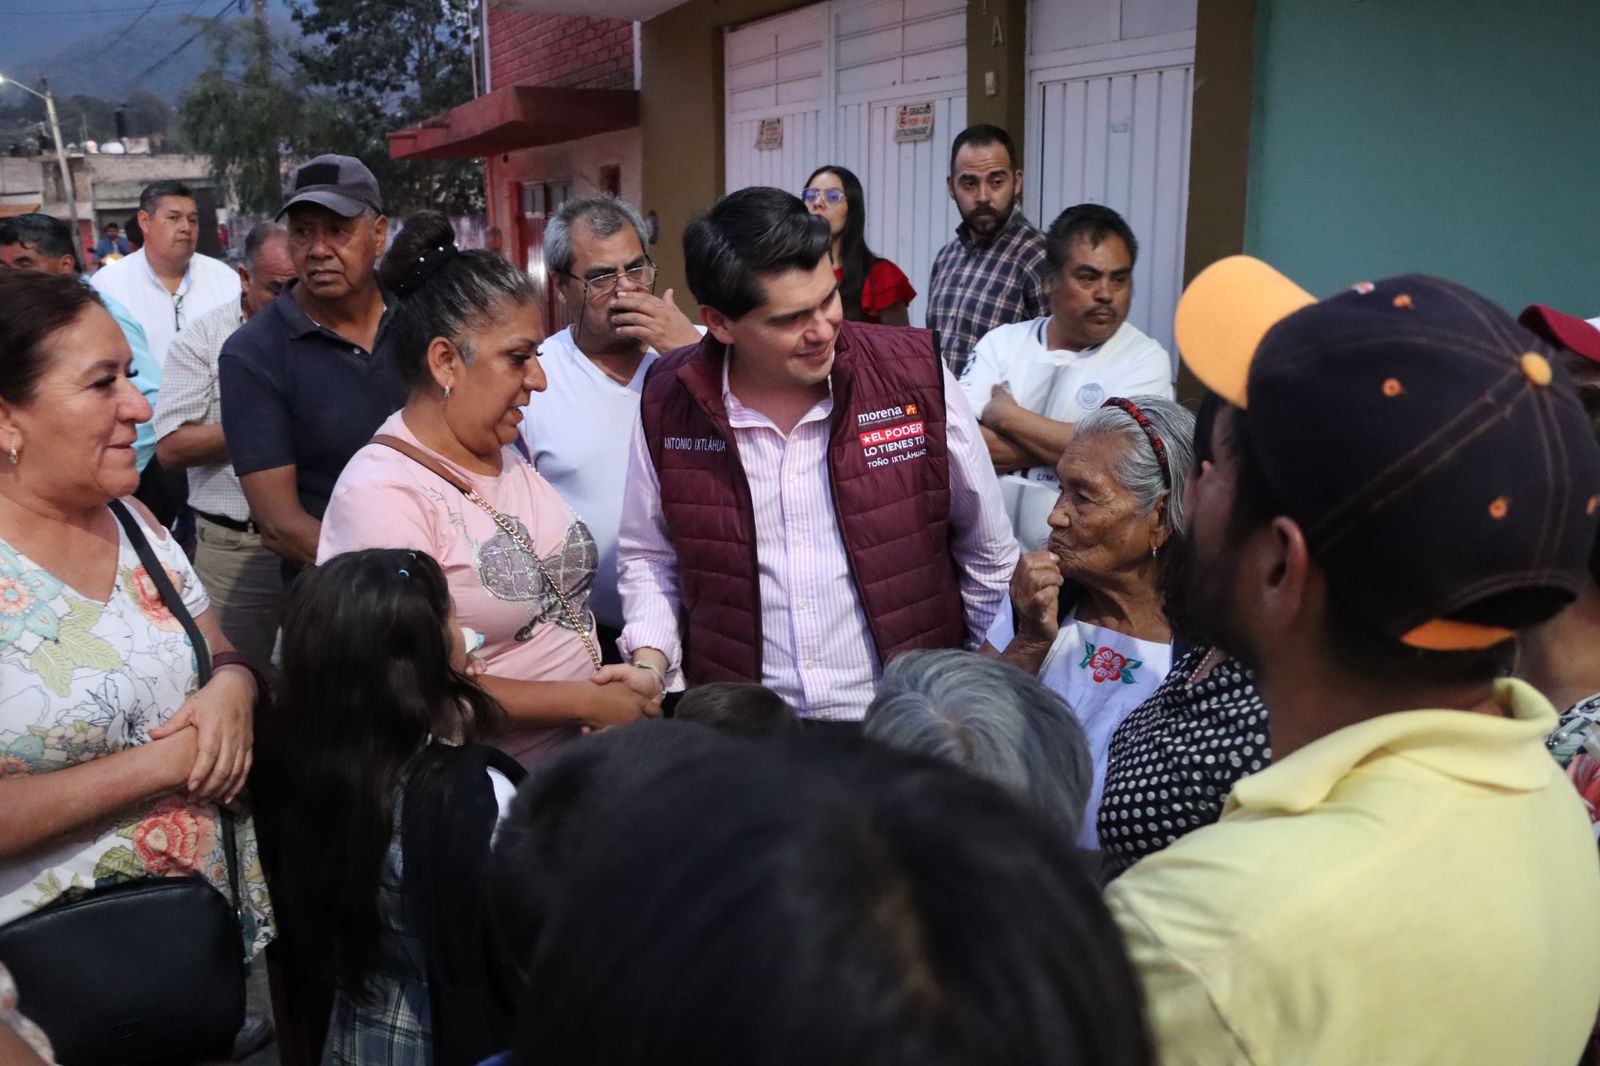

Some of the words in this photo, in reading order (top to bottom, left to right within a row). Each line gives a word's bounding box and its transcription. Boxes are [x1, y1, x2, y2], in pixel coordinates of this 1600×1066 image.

[858, 406, 902, 423] morena
[871, 431, 885, 443] EL
[885, 423, 922, 439] PODER
[664, 437, 692, 450] ANTONIO
[864, 446, 878, 457] LO
[878, 438, 914, 454] TIENES
[867, 457, 889, 469] TOÑO
